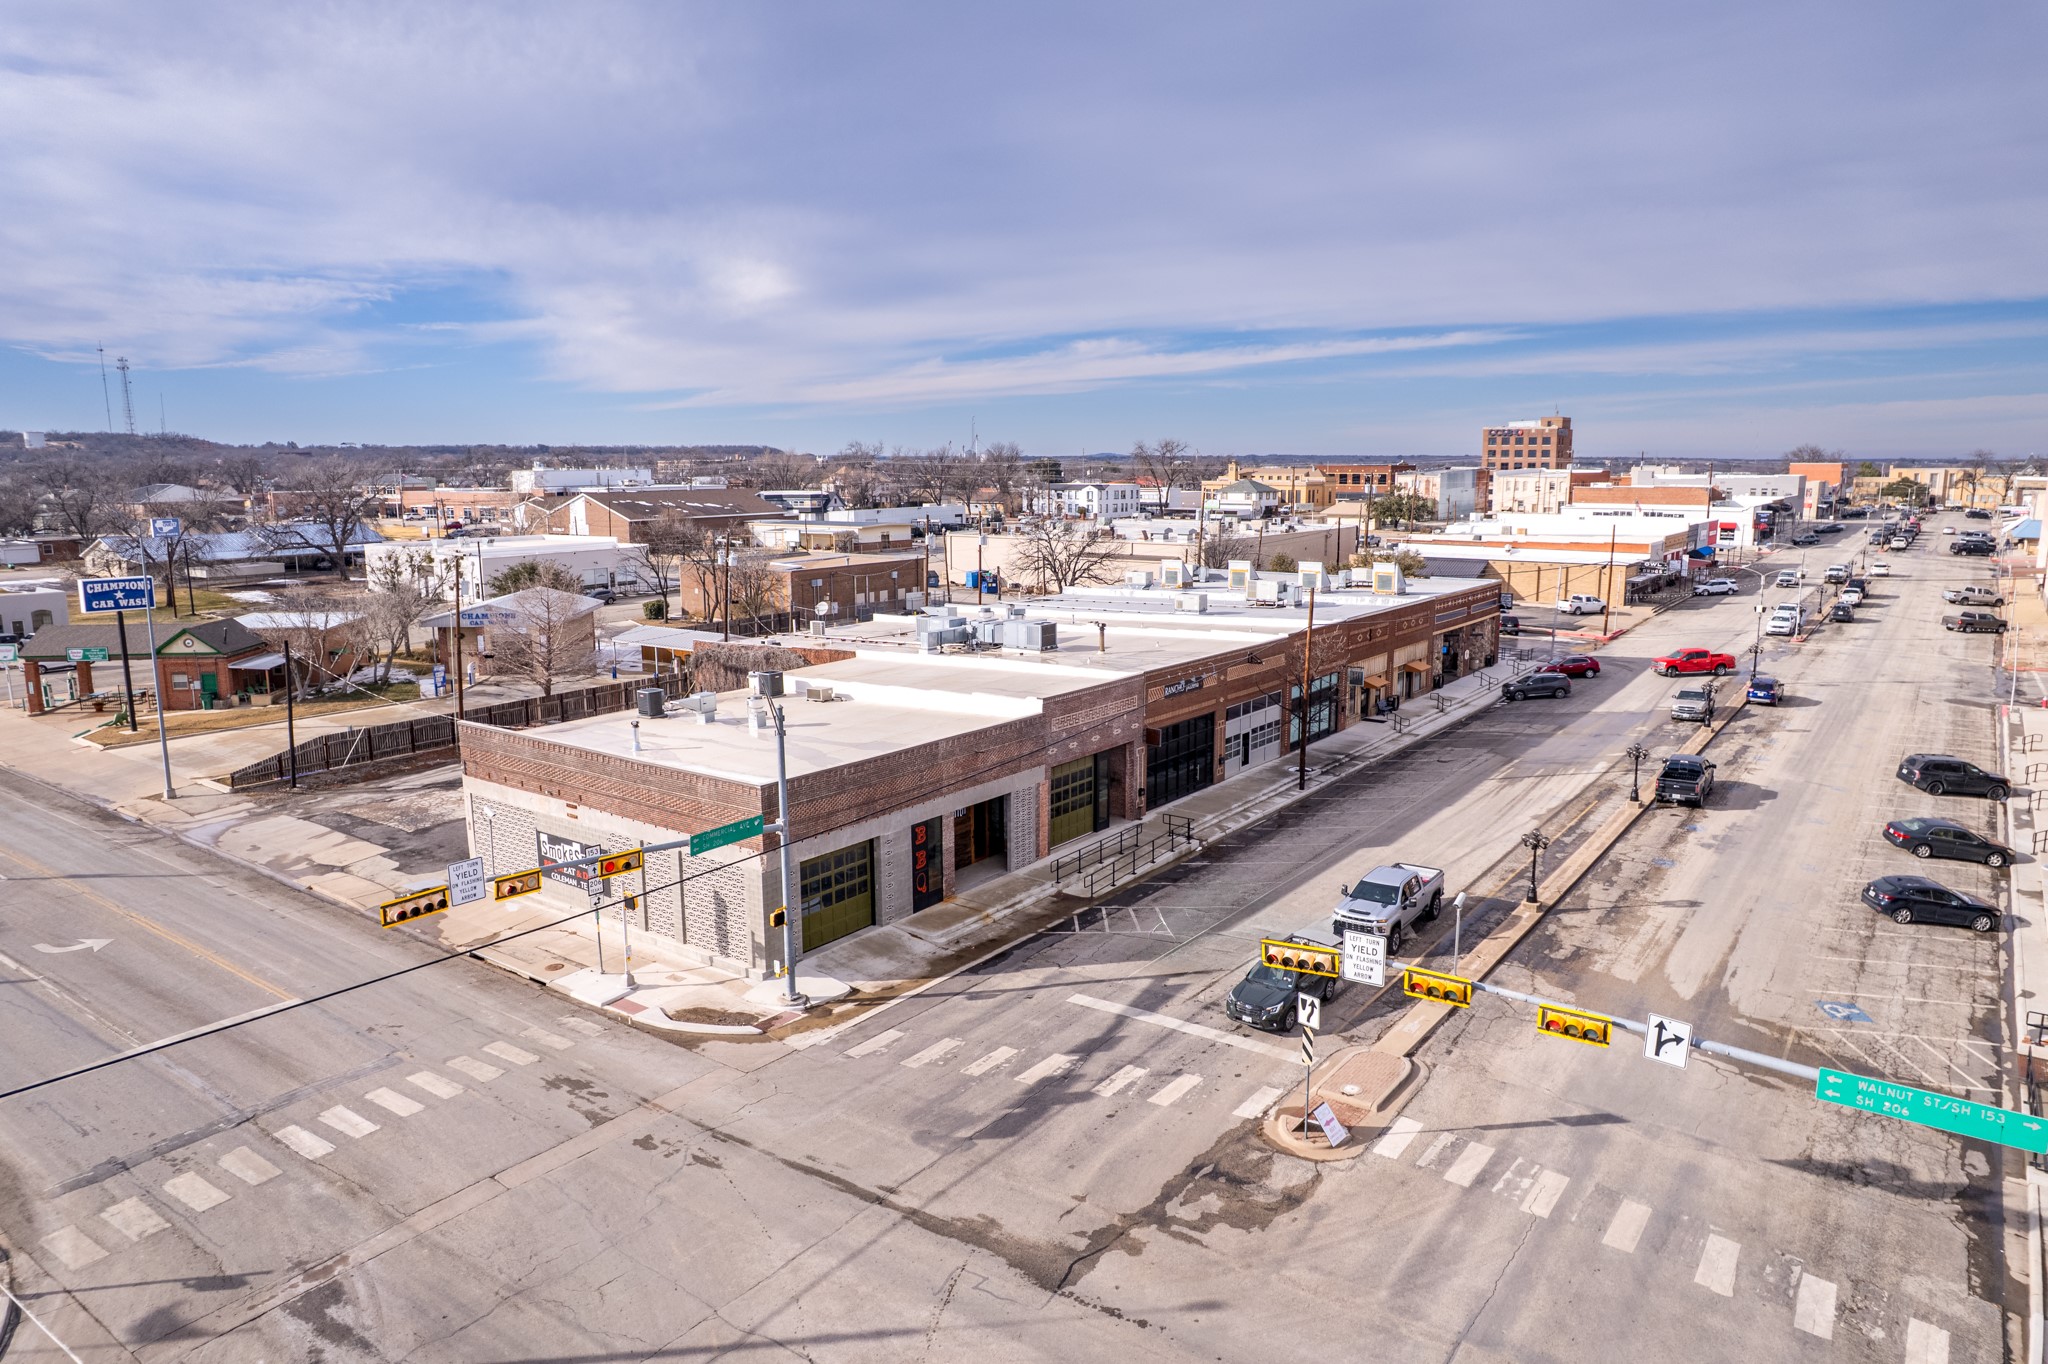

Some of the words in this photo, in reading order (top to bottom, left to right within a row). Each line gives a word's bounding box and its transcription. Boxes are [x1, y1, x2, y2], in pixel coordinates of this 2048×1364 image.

[92, 600, 114, 608] CAR
[702, 826, 736, 840] COMMERCIAL
[740, 821, 750, 829] AVE
[588, 848, 598, 856] 153
[456, 868, 478, 880] YIELD
[551, 872, 578, 886] COLEMAN
[462, 876, 482, 886] FLASHING
[460, 886, 476, 894] YELLOW
[1352, 944, 1378, 956] YIELD
[1356, 956, 1382, 965] FLASHING
[1353, 963, 1374, 972] YELLOW
[1354, 972, 1372, 980] ARROW
[1856, 1096, 1874, 1108] SH
[1882, 1102, 1910, 1116] 206
[1858, 1080, 1914, 1102] WALNUT
[1923, 1096, 1971, 1116] ST/SH
[1980, 1109, 2006, 1124] 153
